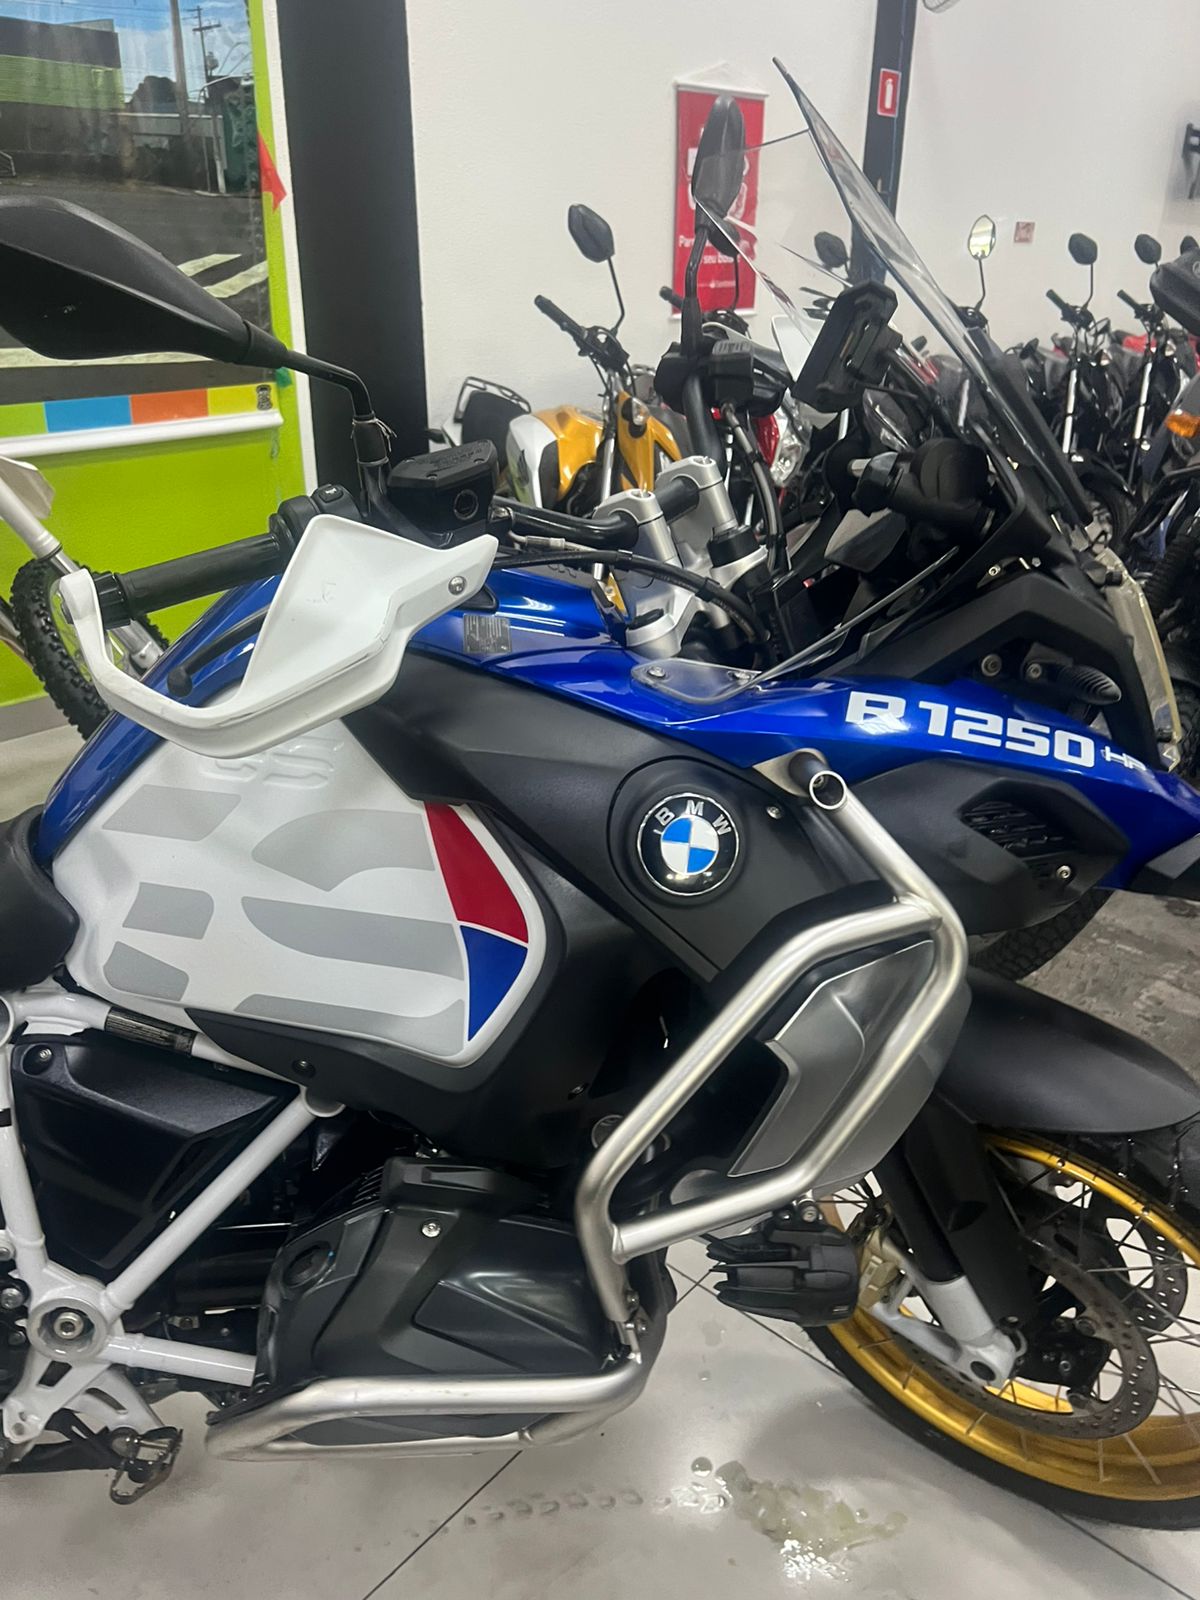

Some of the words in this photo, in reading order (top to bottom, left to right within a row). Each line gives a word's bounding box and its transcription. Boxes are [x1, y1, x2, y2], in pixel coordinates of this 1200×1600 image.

[845, 690, 907, 732] R
[918, 700, 1095, 768] 1250
[654, 799, 732, 836] BMW
